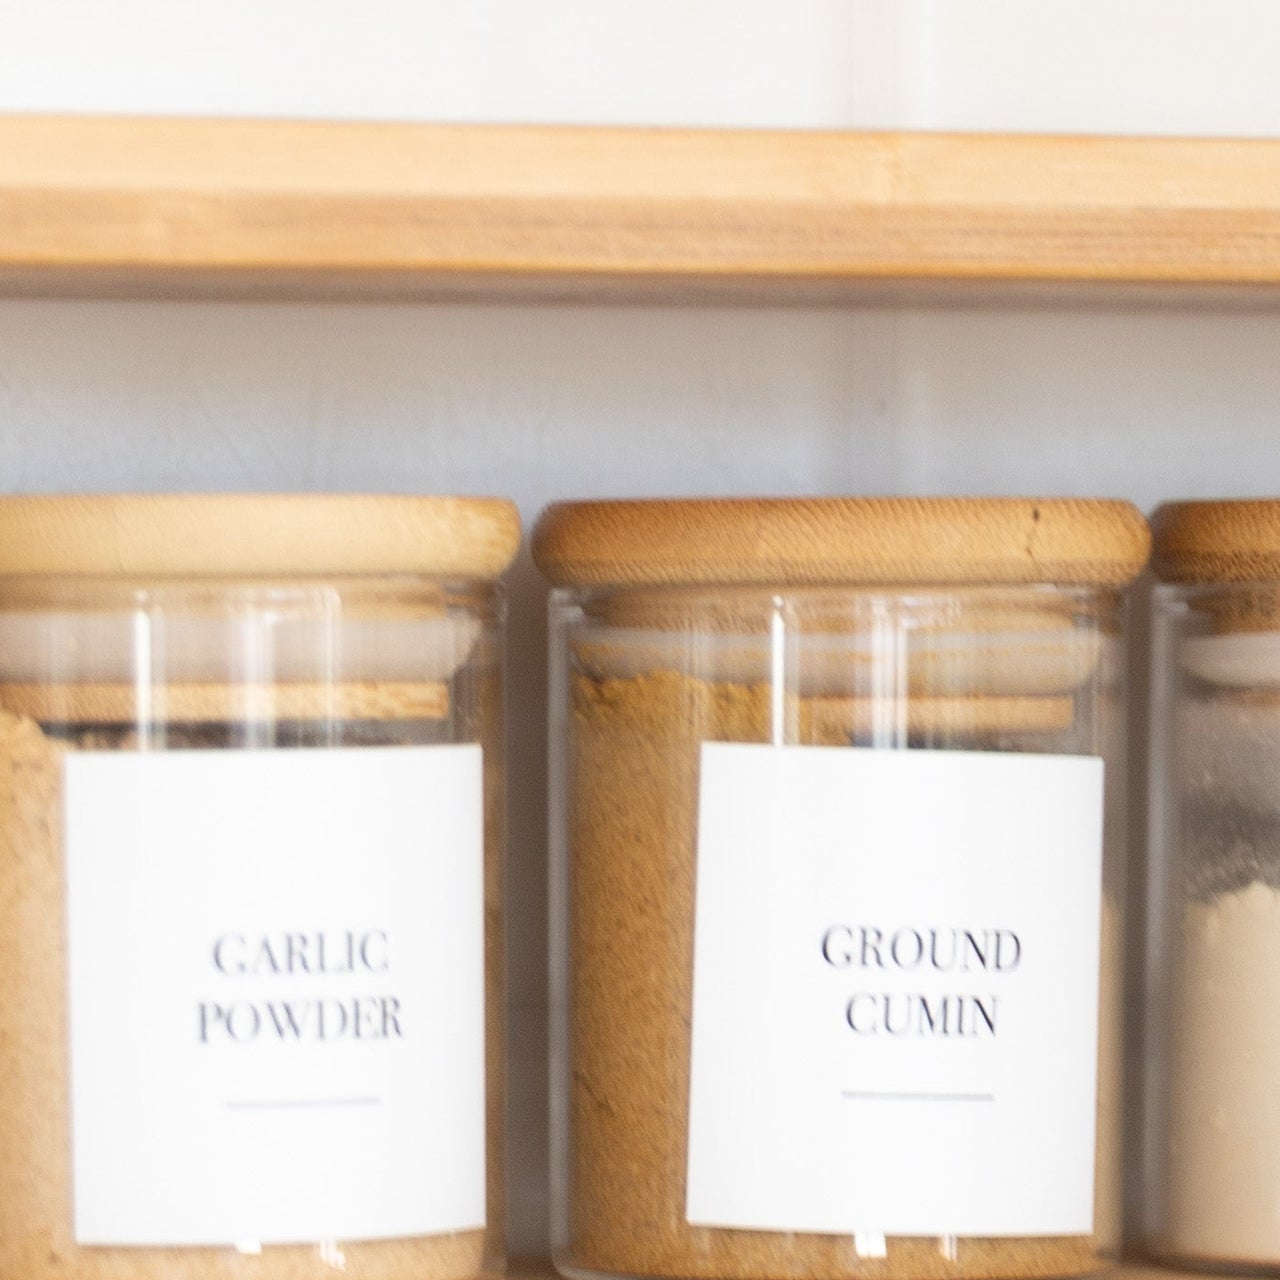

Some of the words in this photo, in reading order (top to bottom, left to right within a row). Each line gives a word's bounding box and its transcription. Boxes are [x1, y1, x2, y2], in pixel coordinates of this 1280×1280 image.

[211, 930, 387, 974] GARLIC
[821, 926, 1022, 970] GROUND
[197, 996, 408, 1044] POWDER
[845, 996, 997, 1038] CUMIN
